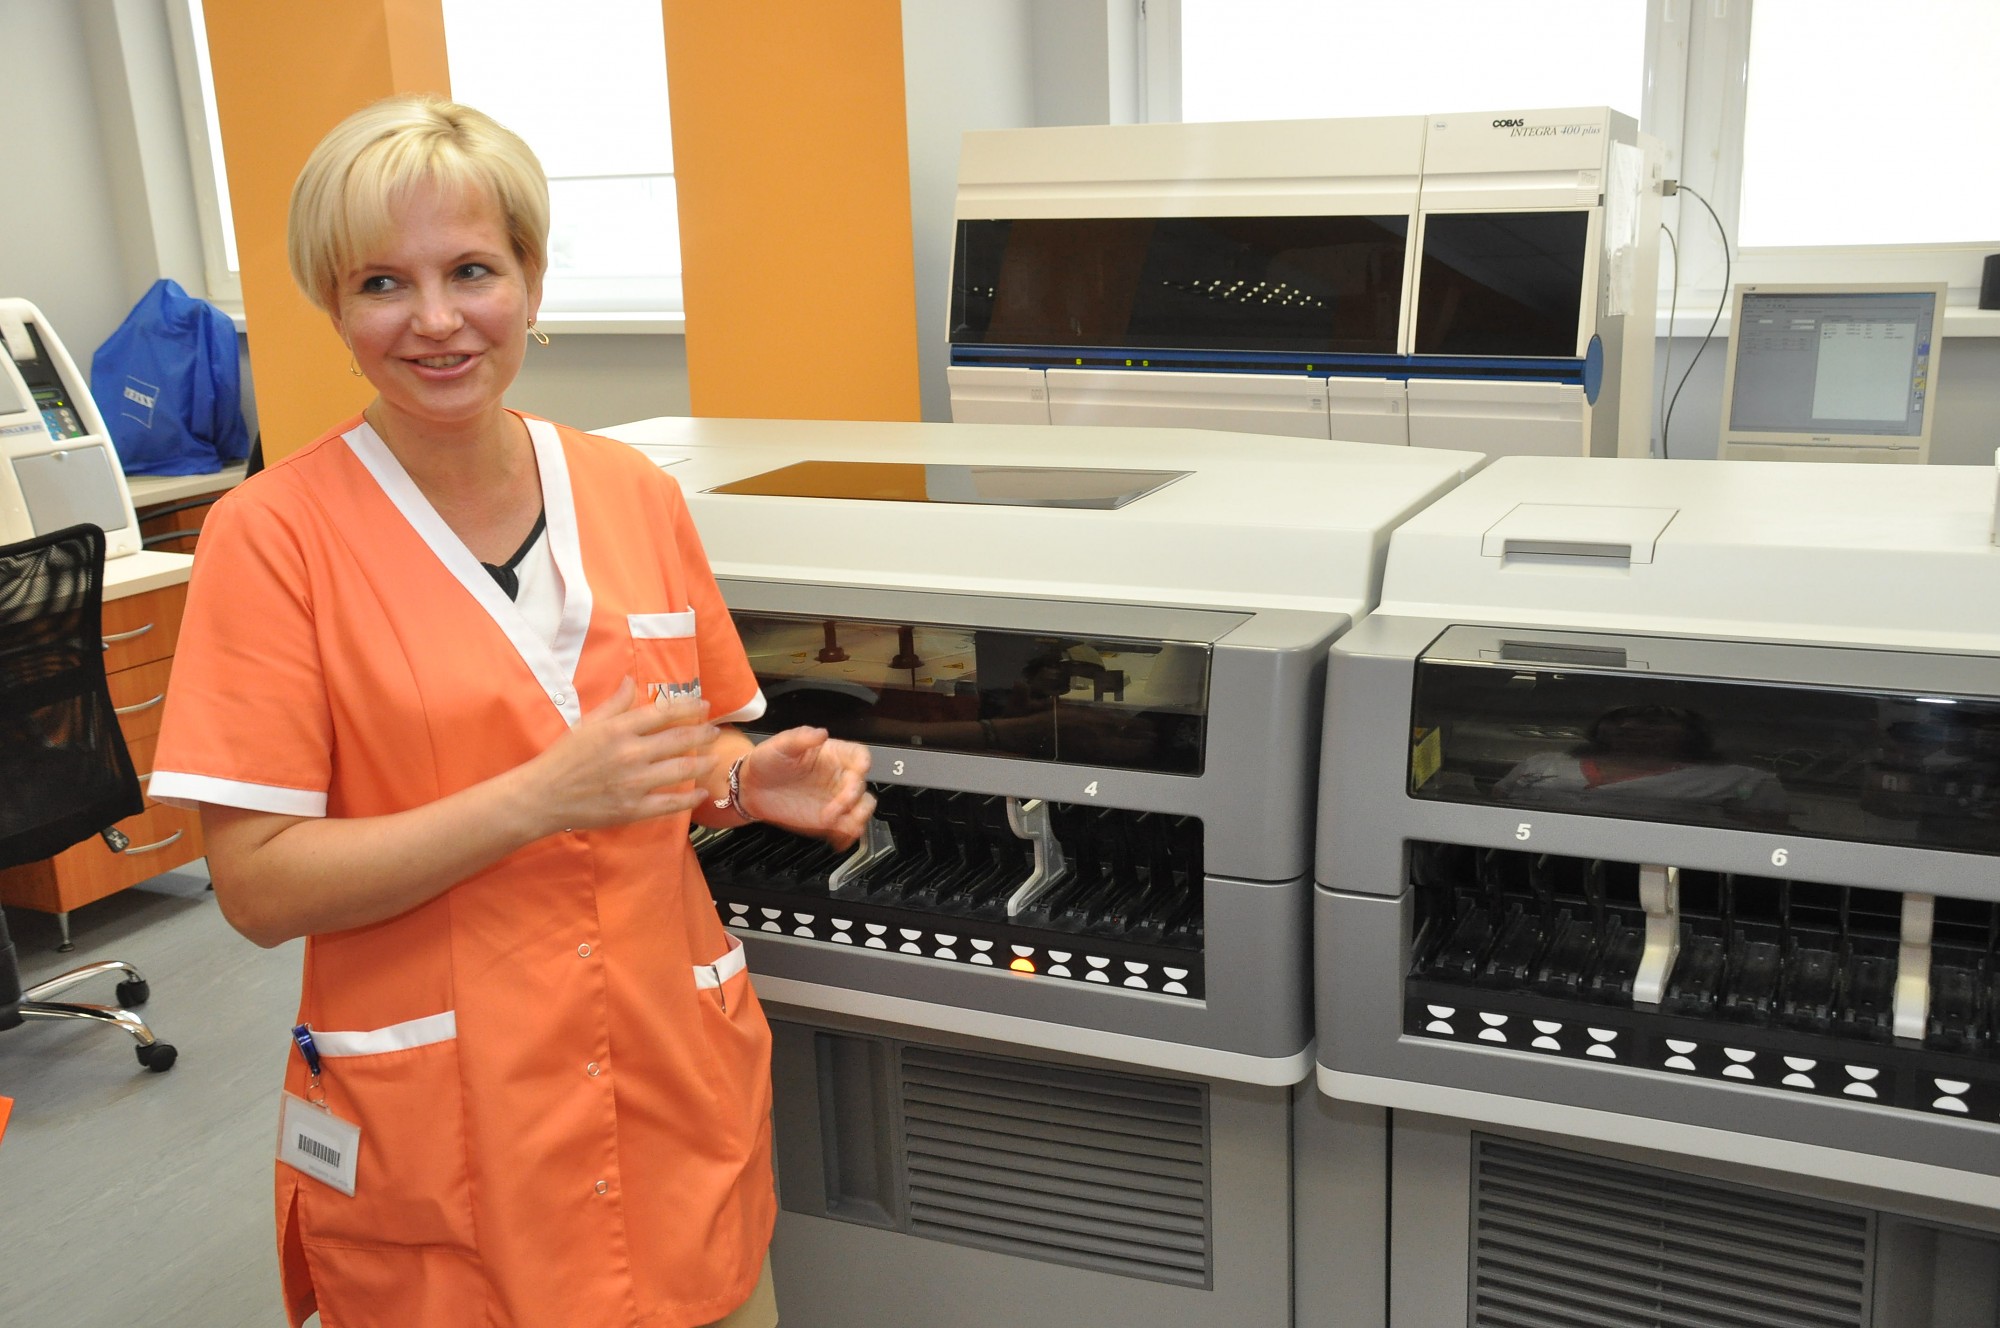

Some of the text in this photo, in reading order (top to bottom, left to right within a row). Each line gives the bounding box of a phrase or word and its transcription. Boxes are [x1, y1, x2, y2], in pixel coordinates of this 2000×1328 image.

[1492, 118, 1524, 128] COBAS
[1510, 125, 1601, 137] INTEGRA 400 plus
[892, 760, 904, 776] 3
[1084, 781, 1098, 797] 4
[1515, 823, 1531, 840] 5
[1771, 848, 1788, 866] 6
